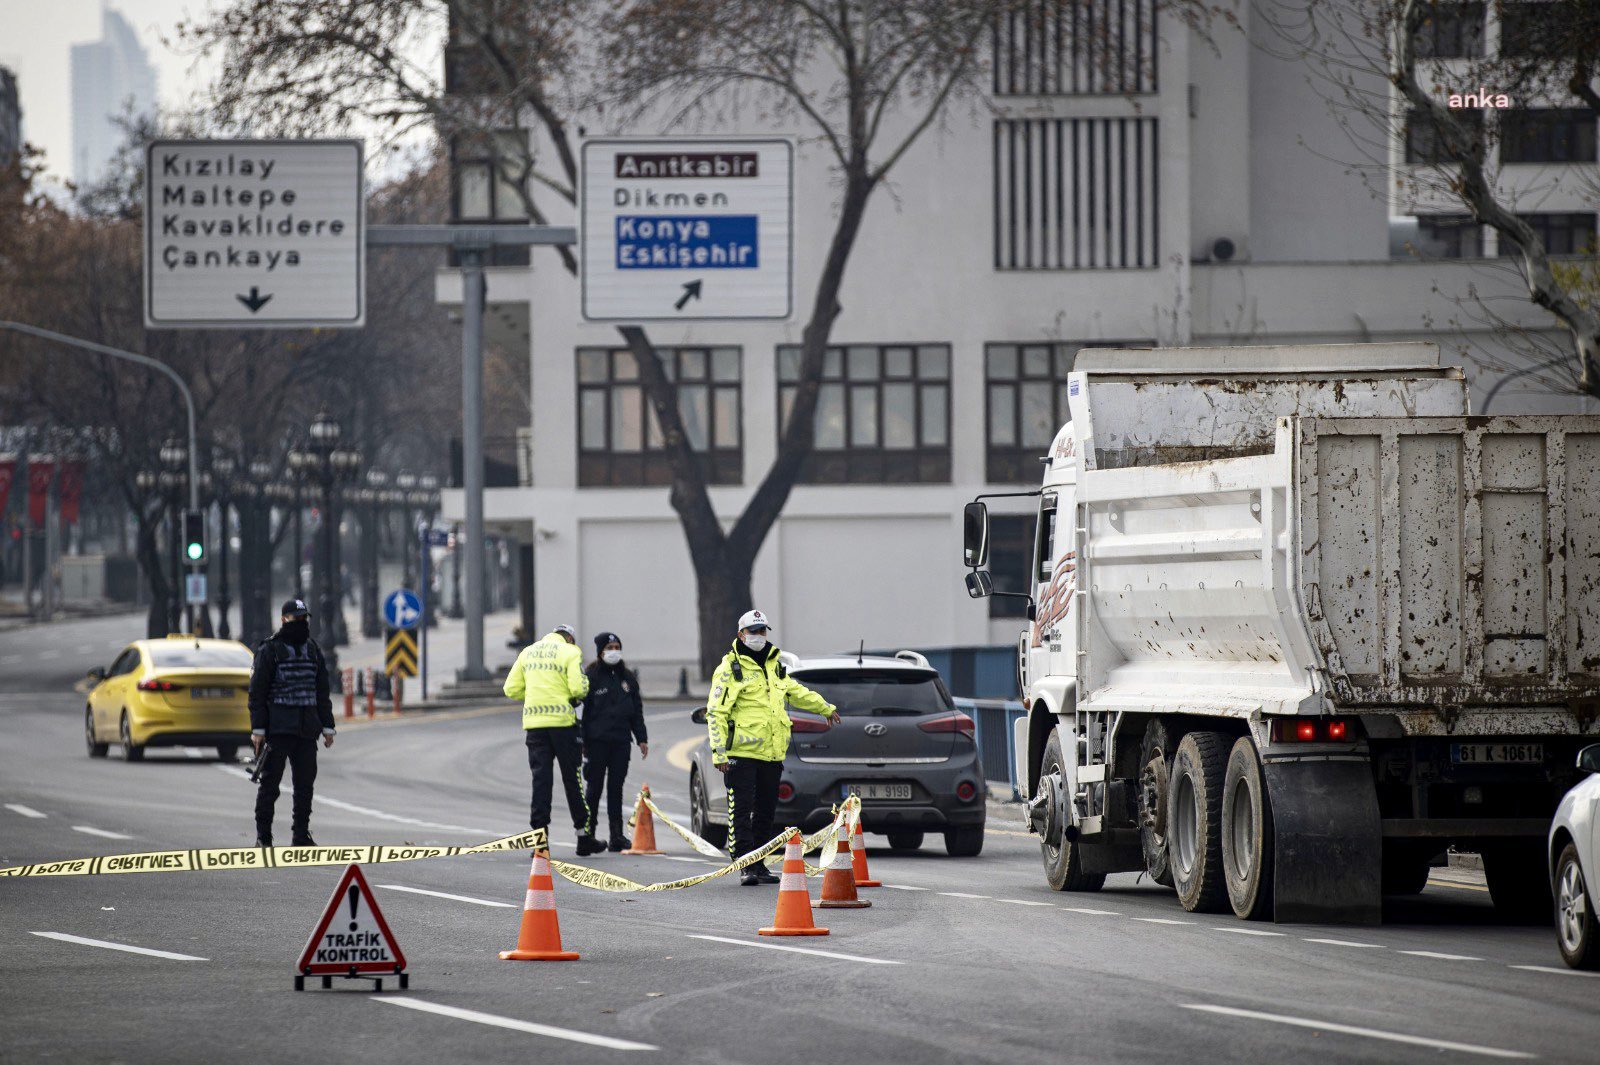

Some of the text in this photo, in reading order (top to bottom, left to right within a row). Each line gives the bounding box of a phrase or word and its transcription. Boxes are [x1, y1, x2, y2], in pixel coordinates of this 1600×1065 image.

[163, 153, 275, 180] Kızılay
[619, 155, 756, 177] Anıtkabir
[163, 185, 297, 211] Maltepe
[614, 188, 728, 207] Dikmen
[162, 214, 345, 236] Kavaklıdere
[618, 218, 711, 242] Konya
[163, 246, 300, 271] Çankaya
[619, 243, 753, 267] Eskişehir
[1461, 745, 1476, 761] 61
[1486, 745, 1494, 761] K
[869, 785, 877, 797] N
[885, 785, 910, 797] 9198
[326, 931, 380, 947] TRAFİK
[317, 948, 388, 962] KONTROL
